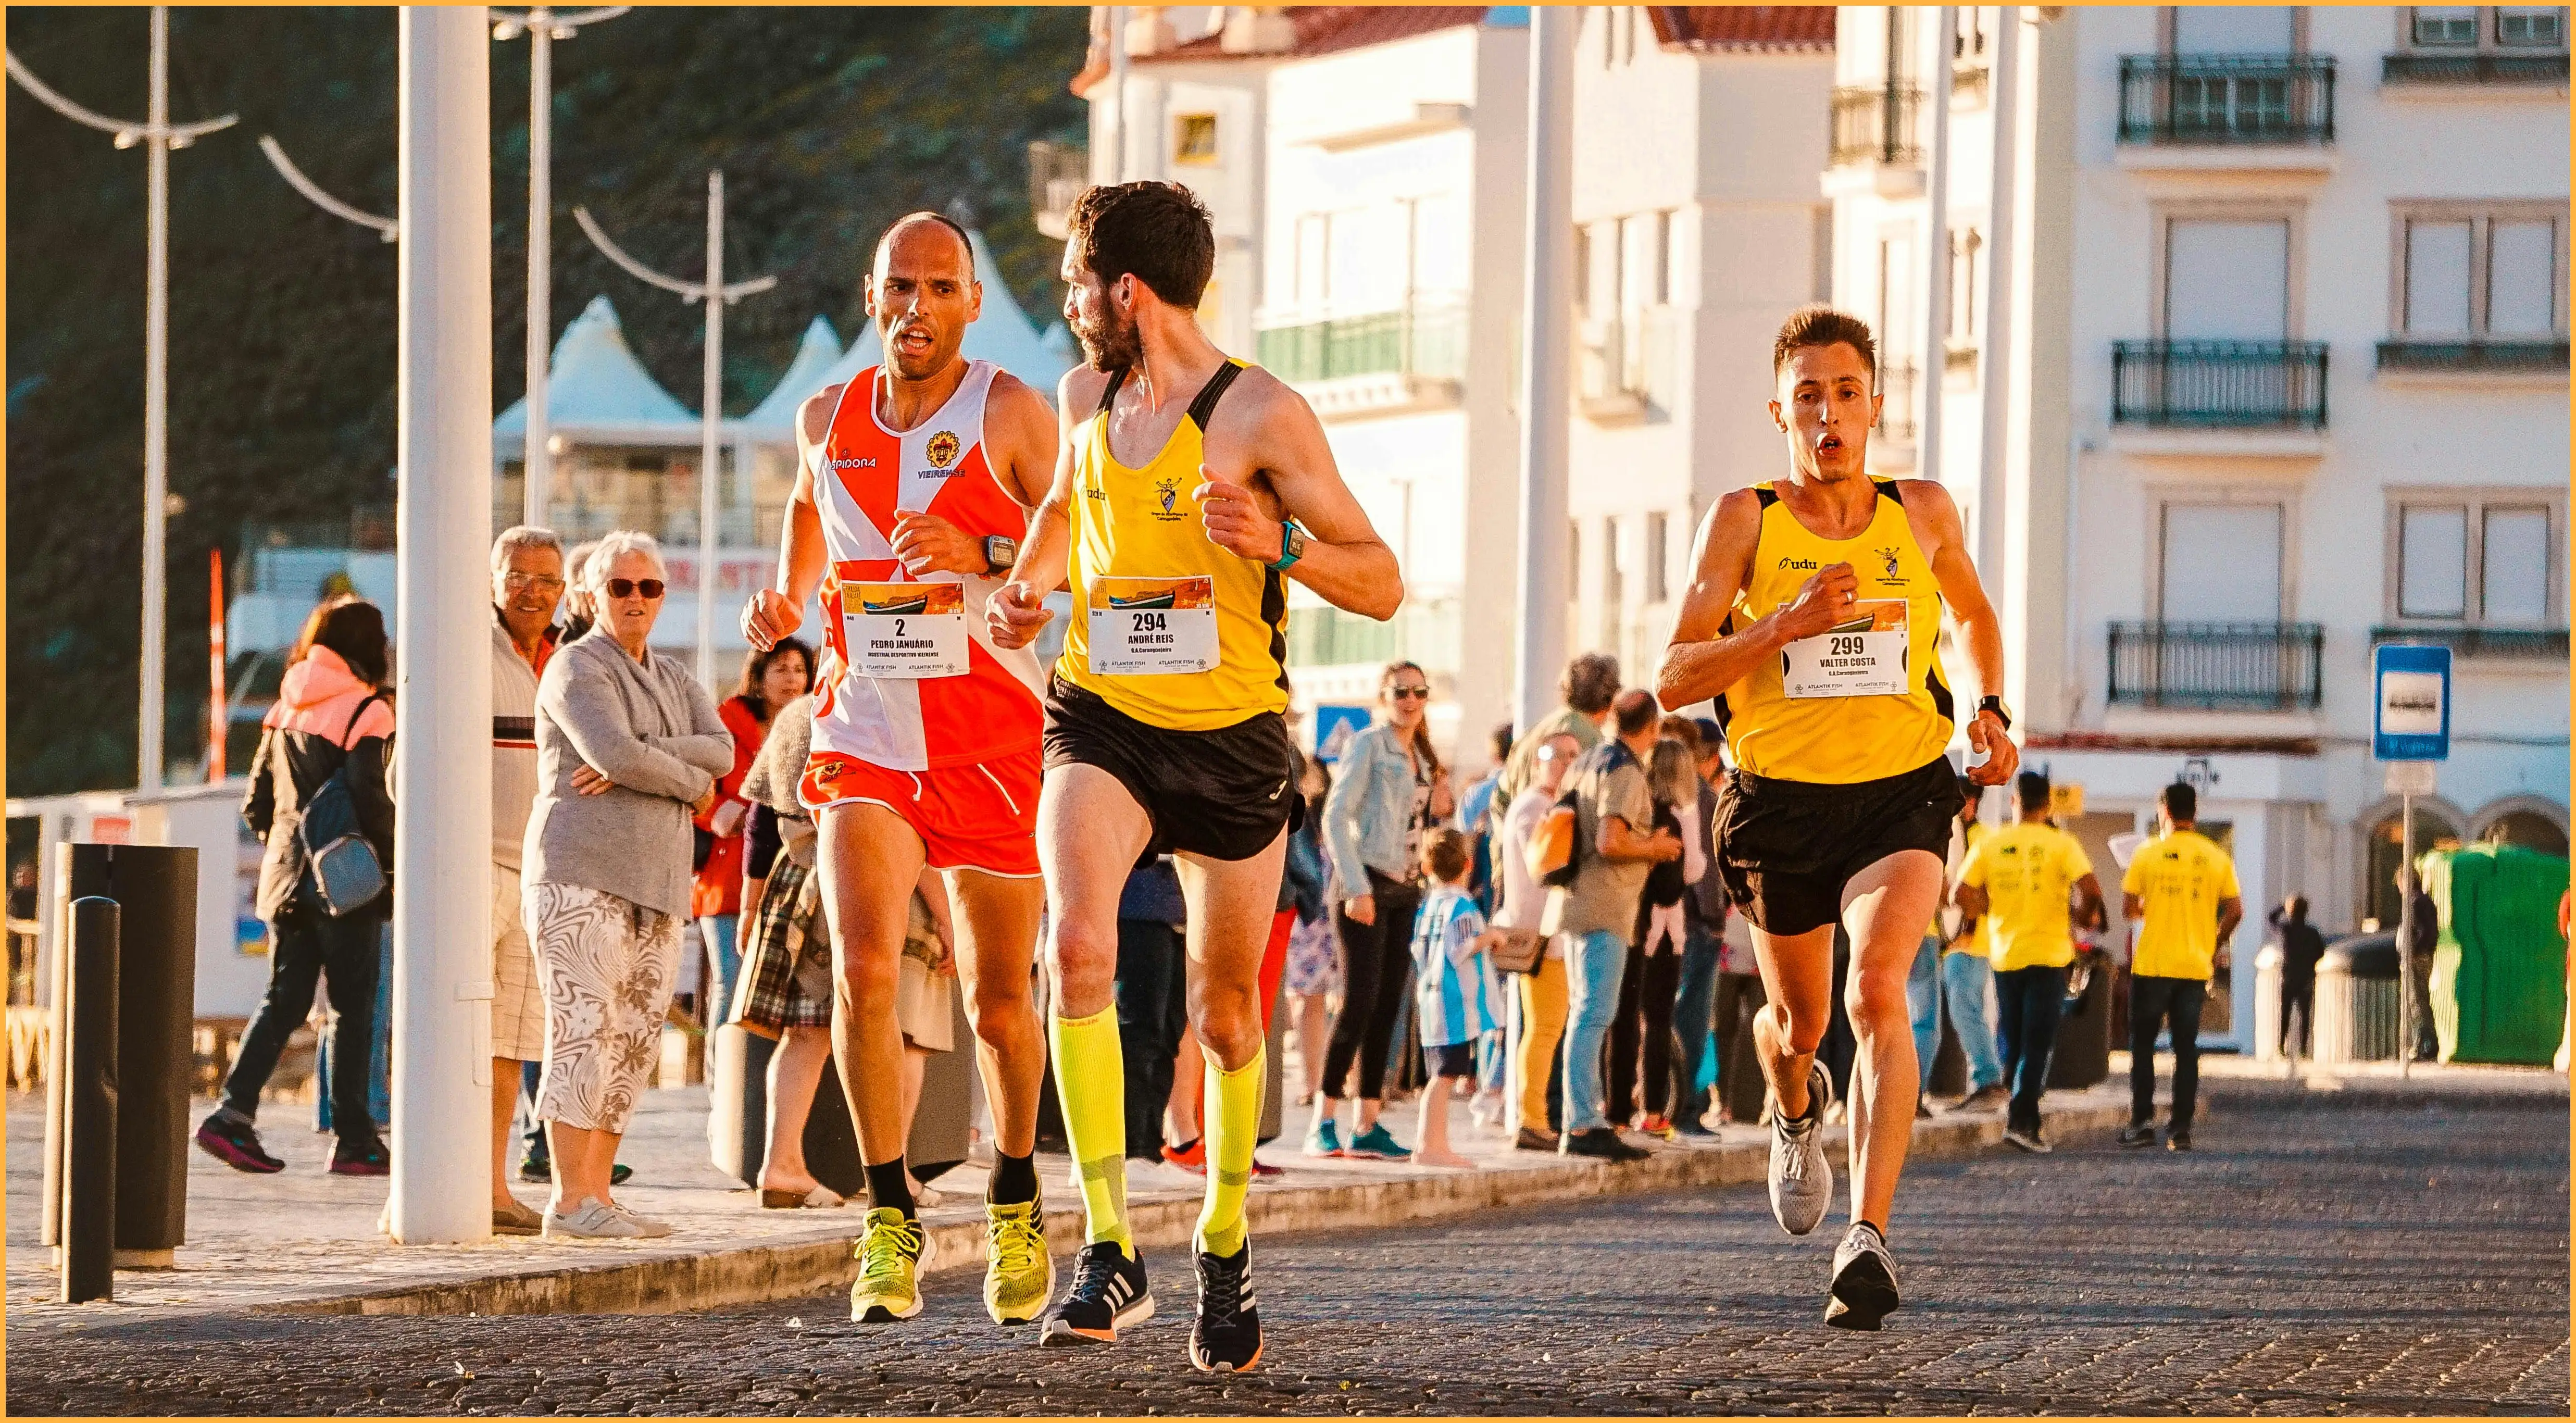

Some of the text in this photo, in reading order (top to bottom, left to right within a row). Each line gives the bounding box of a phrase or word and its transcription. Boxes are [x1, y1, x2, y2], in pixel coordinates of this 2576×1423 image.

[918, 469, 966, 479] VIEIRENSE
[1791, 558, 1818, 569] udu
[895, 619, 906, 636] 2
[1132, 613, 1167, 632] 294
[871, 638, 934, 649] PEDRO JANUÁRIO
[1128, 633, 1174, 644] ANDRÉ REIS
[1830, 636, 1864, 655] 299
[1820, 657, 1876, 668] VALTER COSTA
